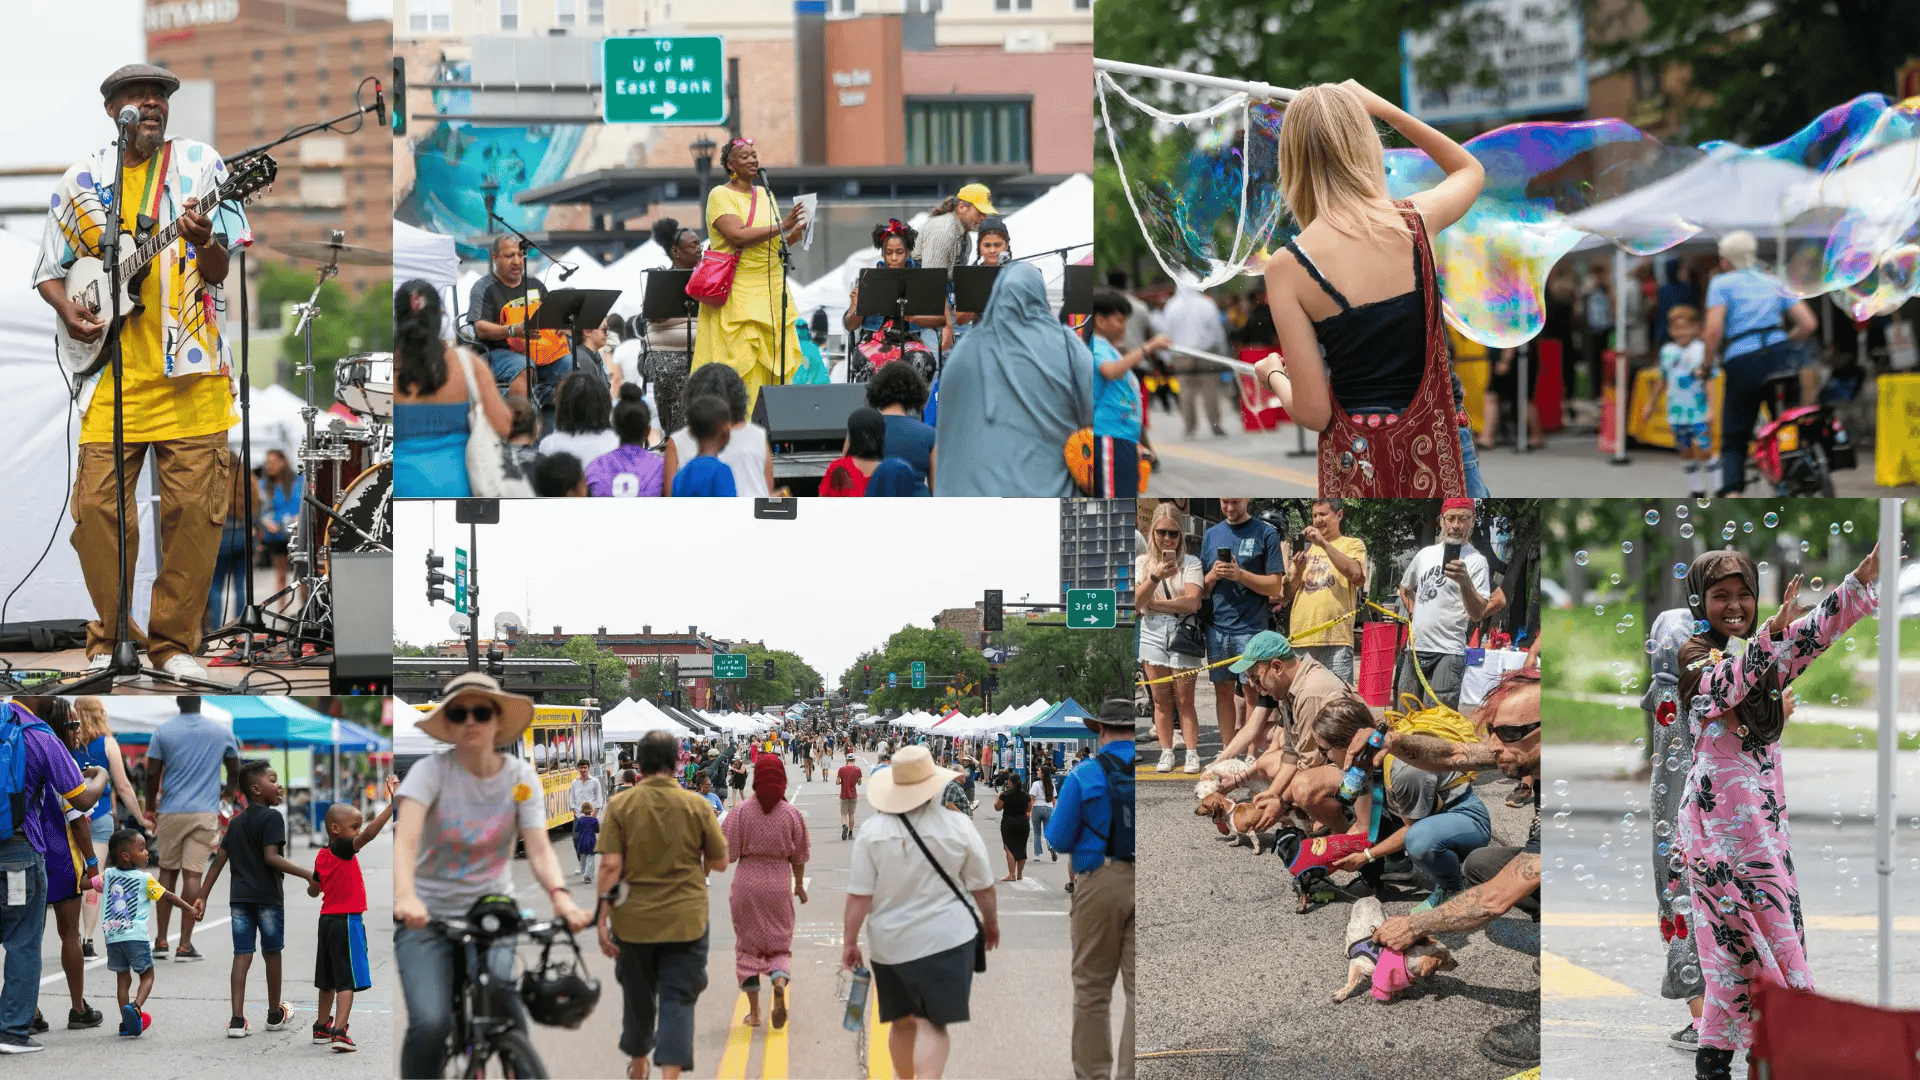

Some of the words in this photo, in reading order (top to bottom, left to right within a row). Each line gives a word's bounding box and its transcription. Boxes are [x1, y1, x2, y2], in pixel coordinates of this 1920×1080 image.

[655, 39, 672, 52] TO
[632, 57, 646, 73] U
[653, 57, 672, 73] of
[680, 57, 694, 73] M
[615, 79, 656, 95] East
[665, 78, 712, 95] Bank
[1074, 602, 1092, 611] 3rd
[1097, 602, 1109, 611] St
